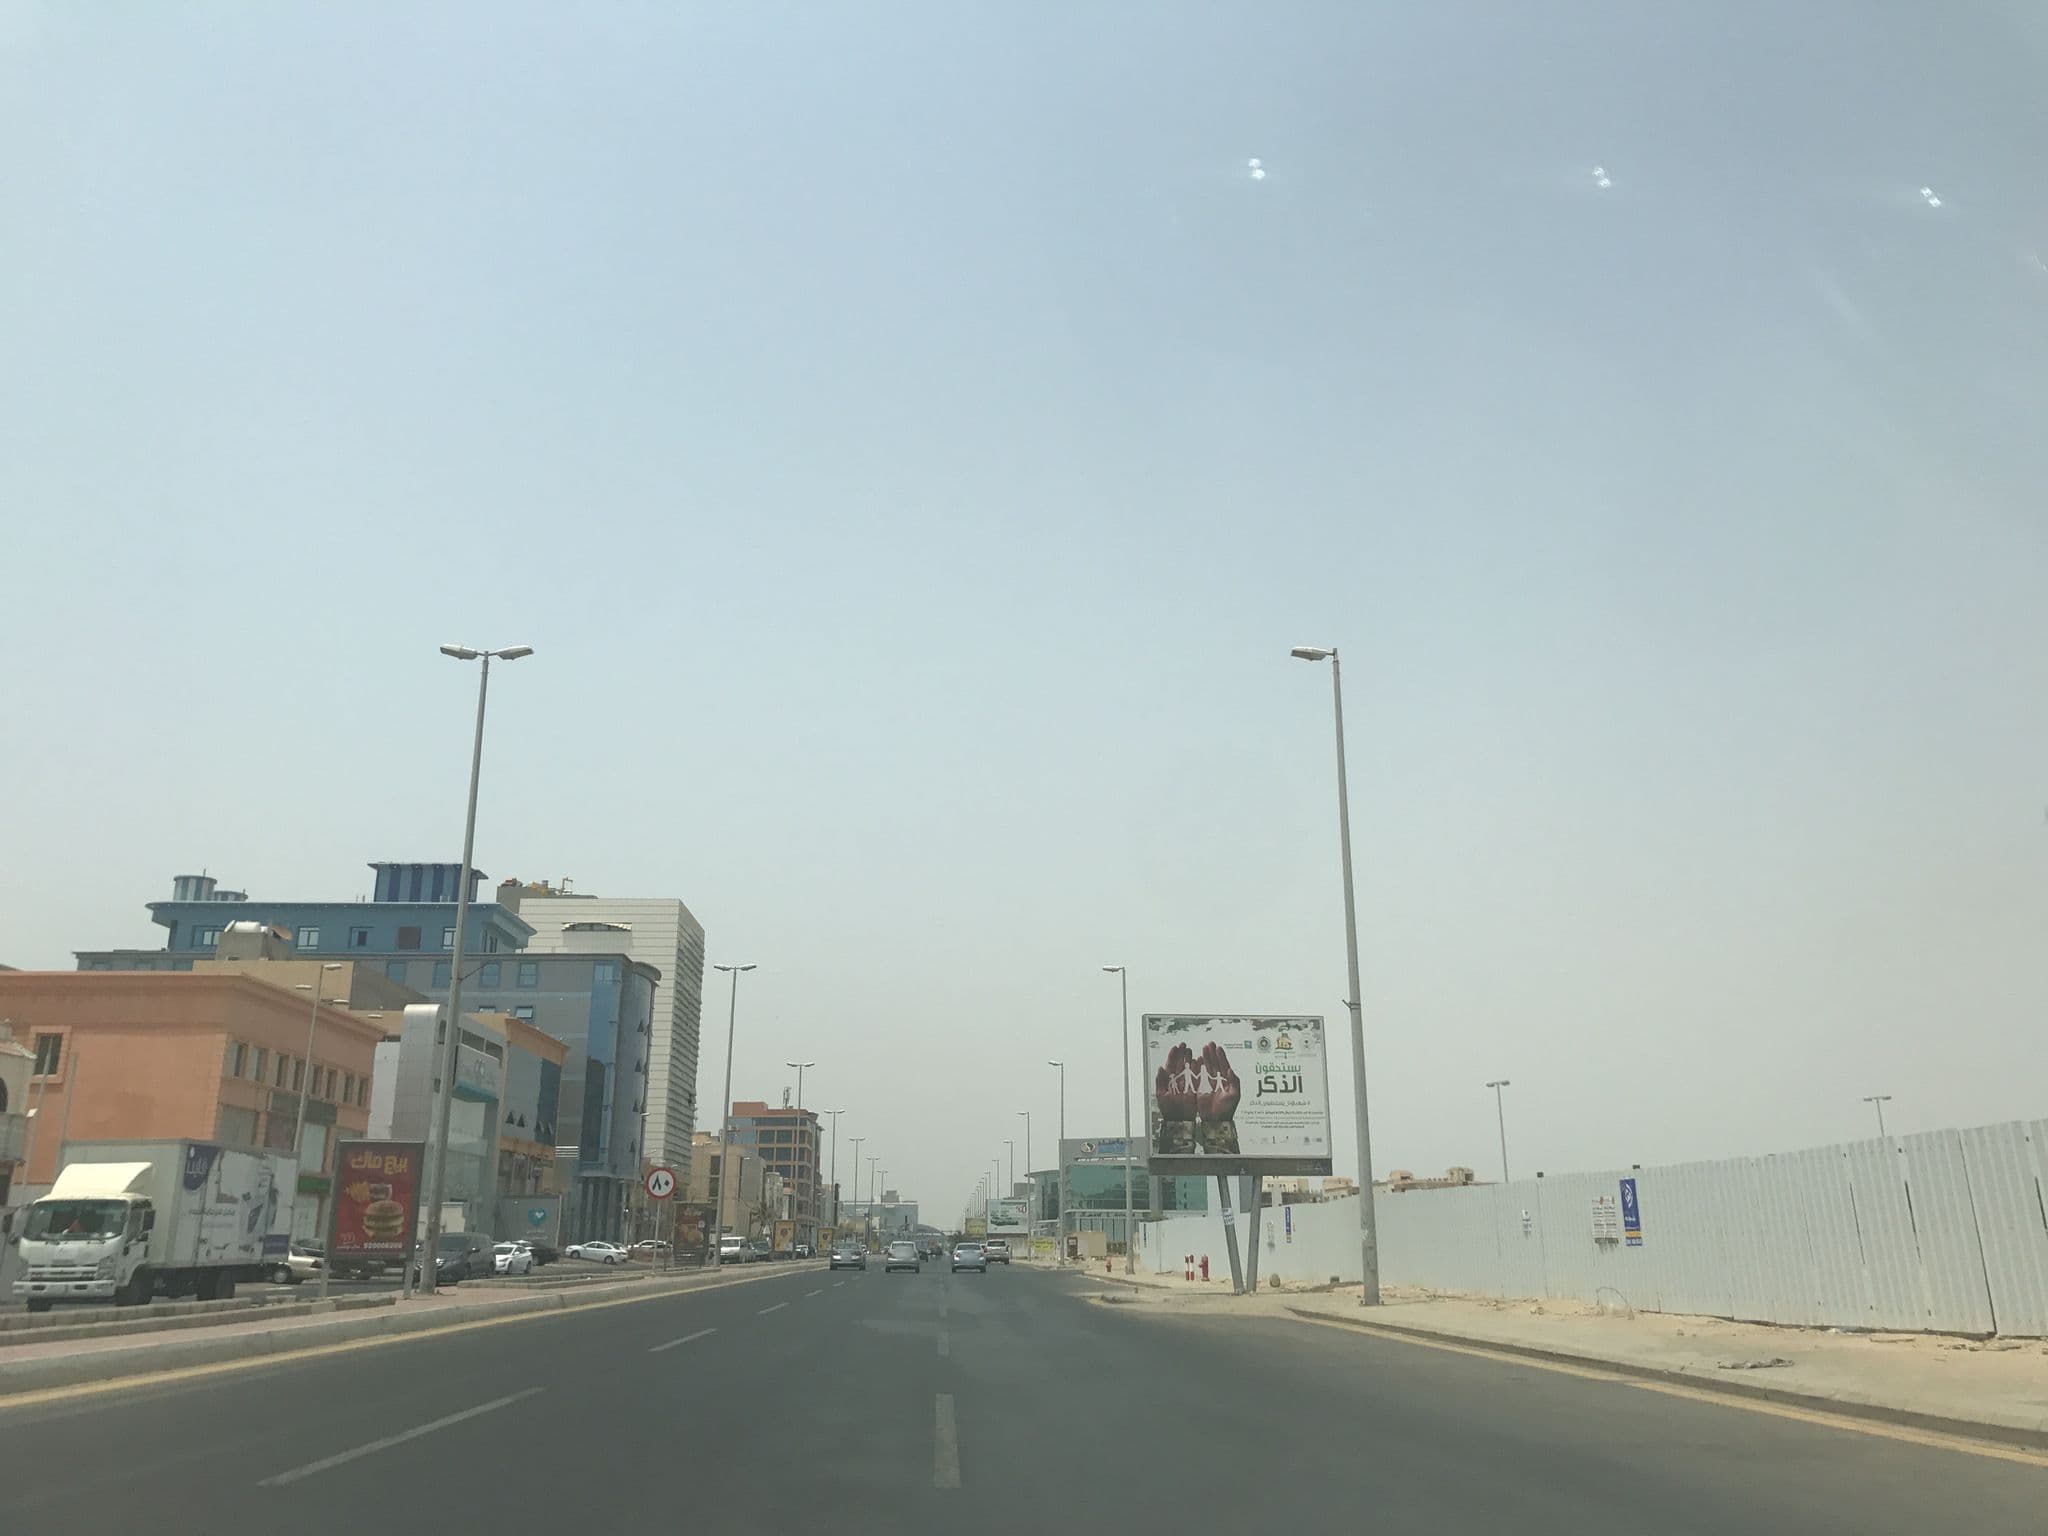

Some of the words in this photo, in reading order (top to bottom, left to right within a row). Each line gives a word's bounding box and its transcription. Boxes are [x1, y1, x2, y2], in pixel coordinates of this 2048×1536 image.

[1255, 1062, 1302, 1074] يستحقون
[1256, 1074, 1303, 1098] الذكر
[652, 1174, 670, 1191] ٨٠
